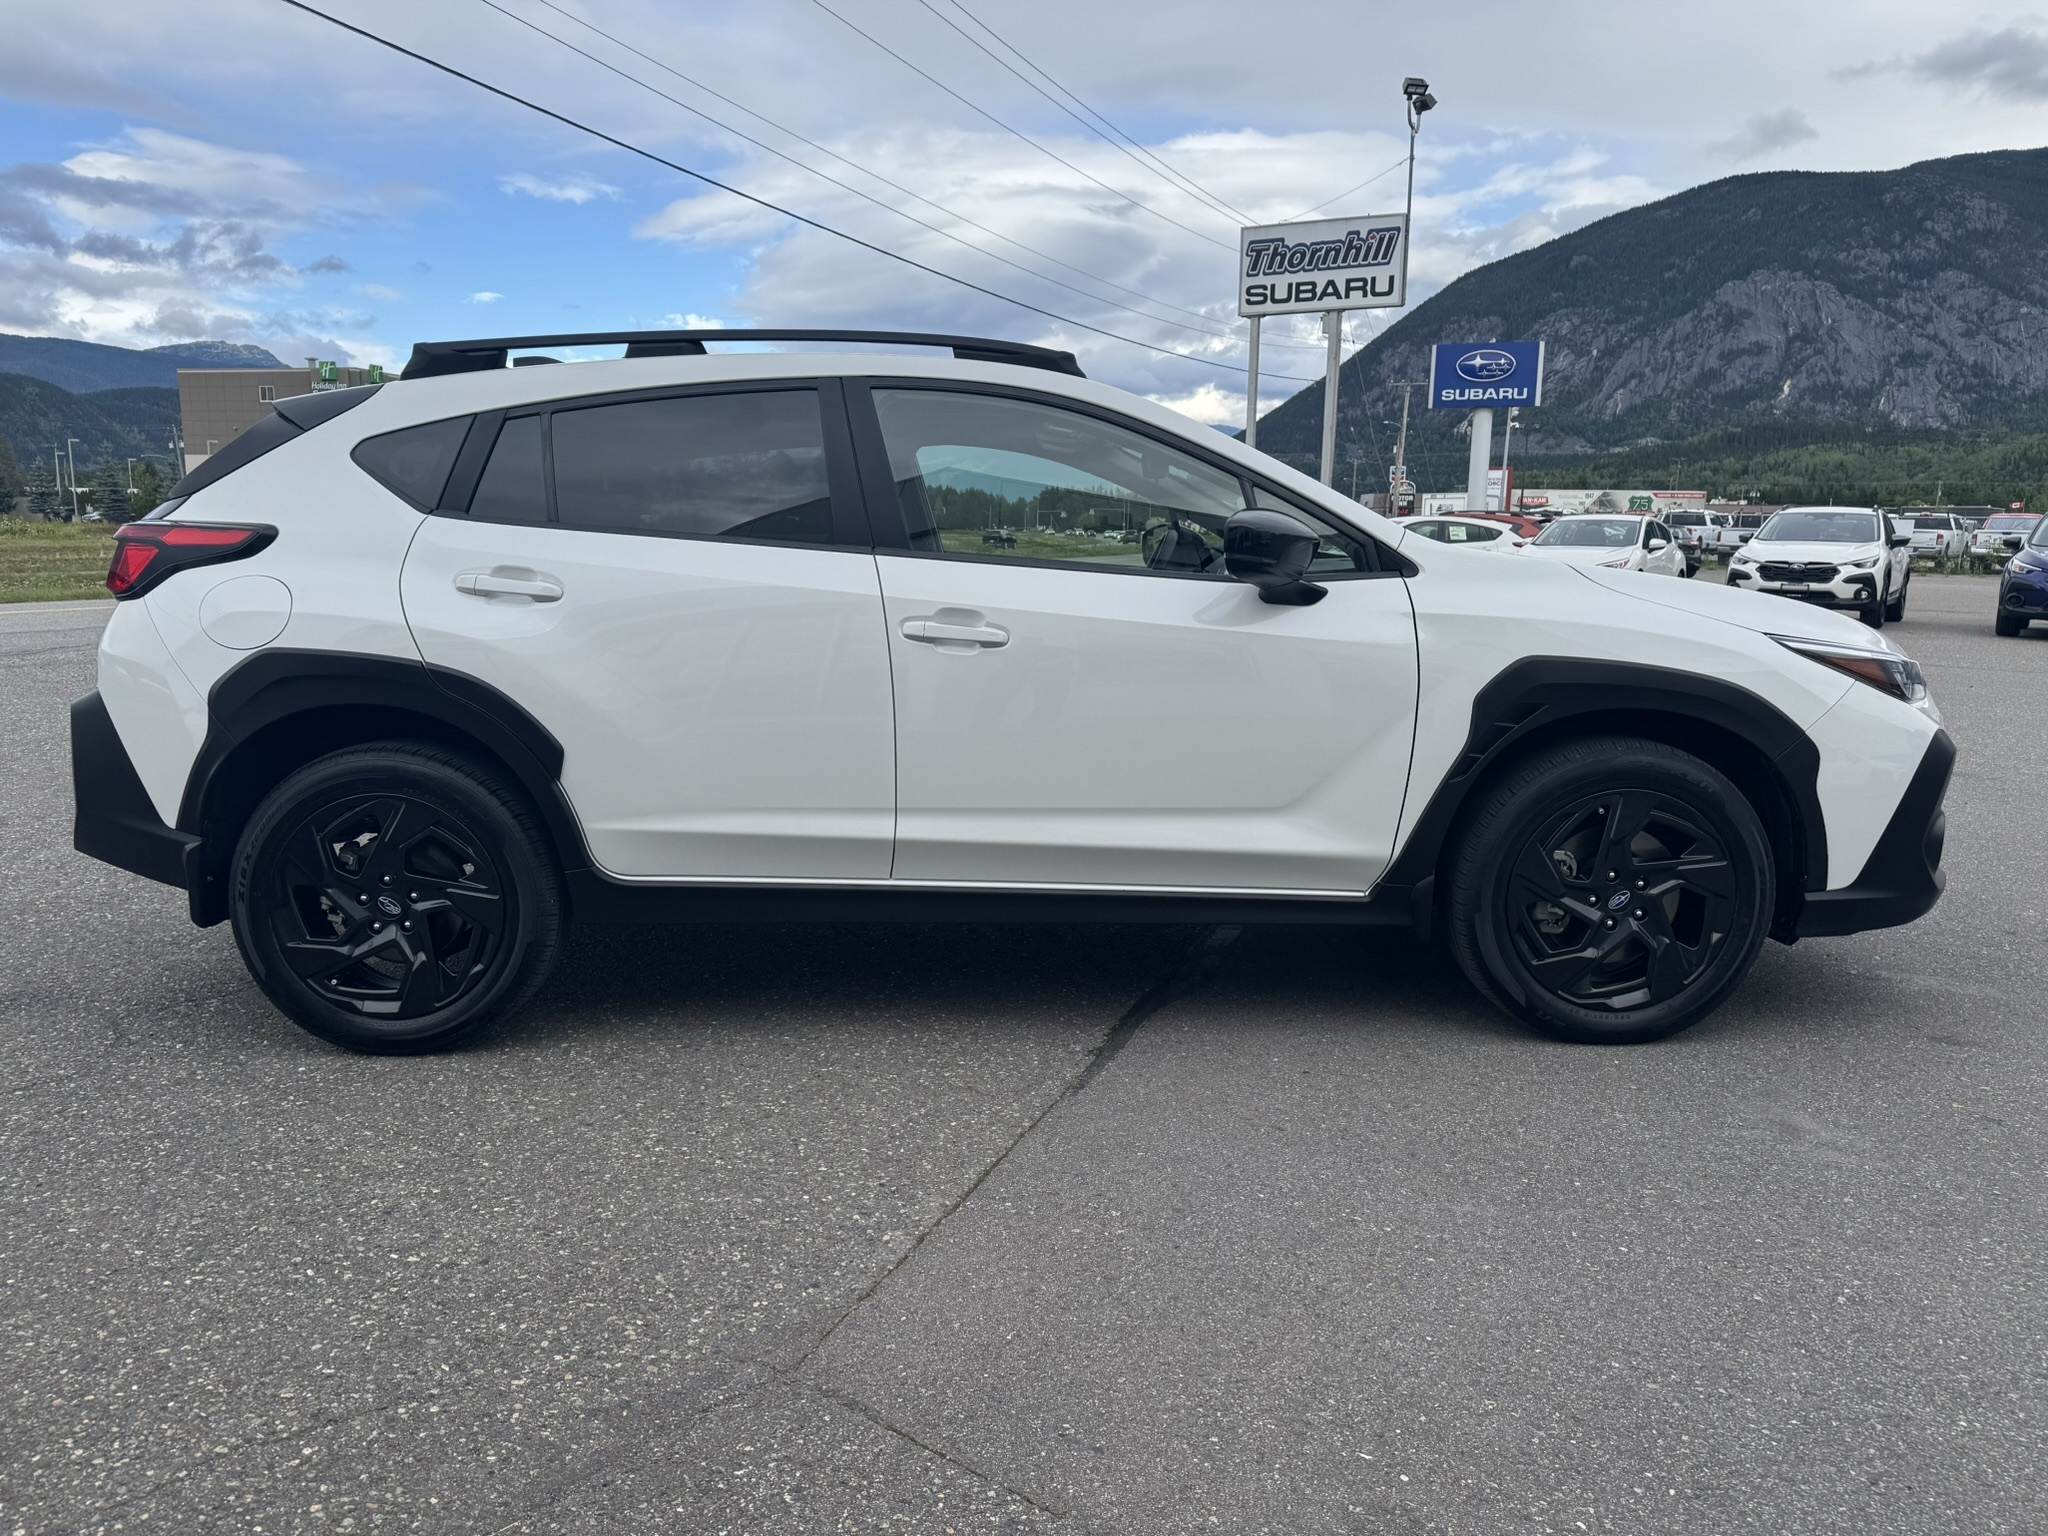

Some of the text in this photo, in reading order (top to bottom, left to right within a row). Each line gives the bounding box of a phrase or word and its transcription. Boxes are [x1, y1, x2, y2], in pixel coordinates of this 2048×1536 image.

[1246, 226, 1401, 277] Thornhill
[1245, 275, 1395, 306] SUBARU
[311, 381, 347, 390] Holiday Inn
[1441, 387, 1528, 401] SUBARU
[1633, 499, 1649, 511] 75
